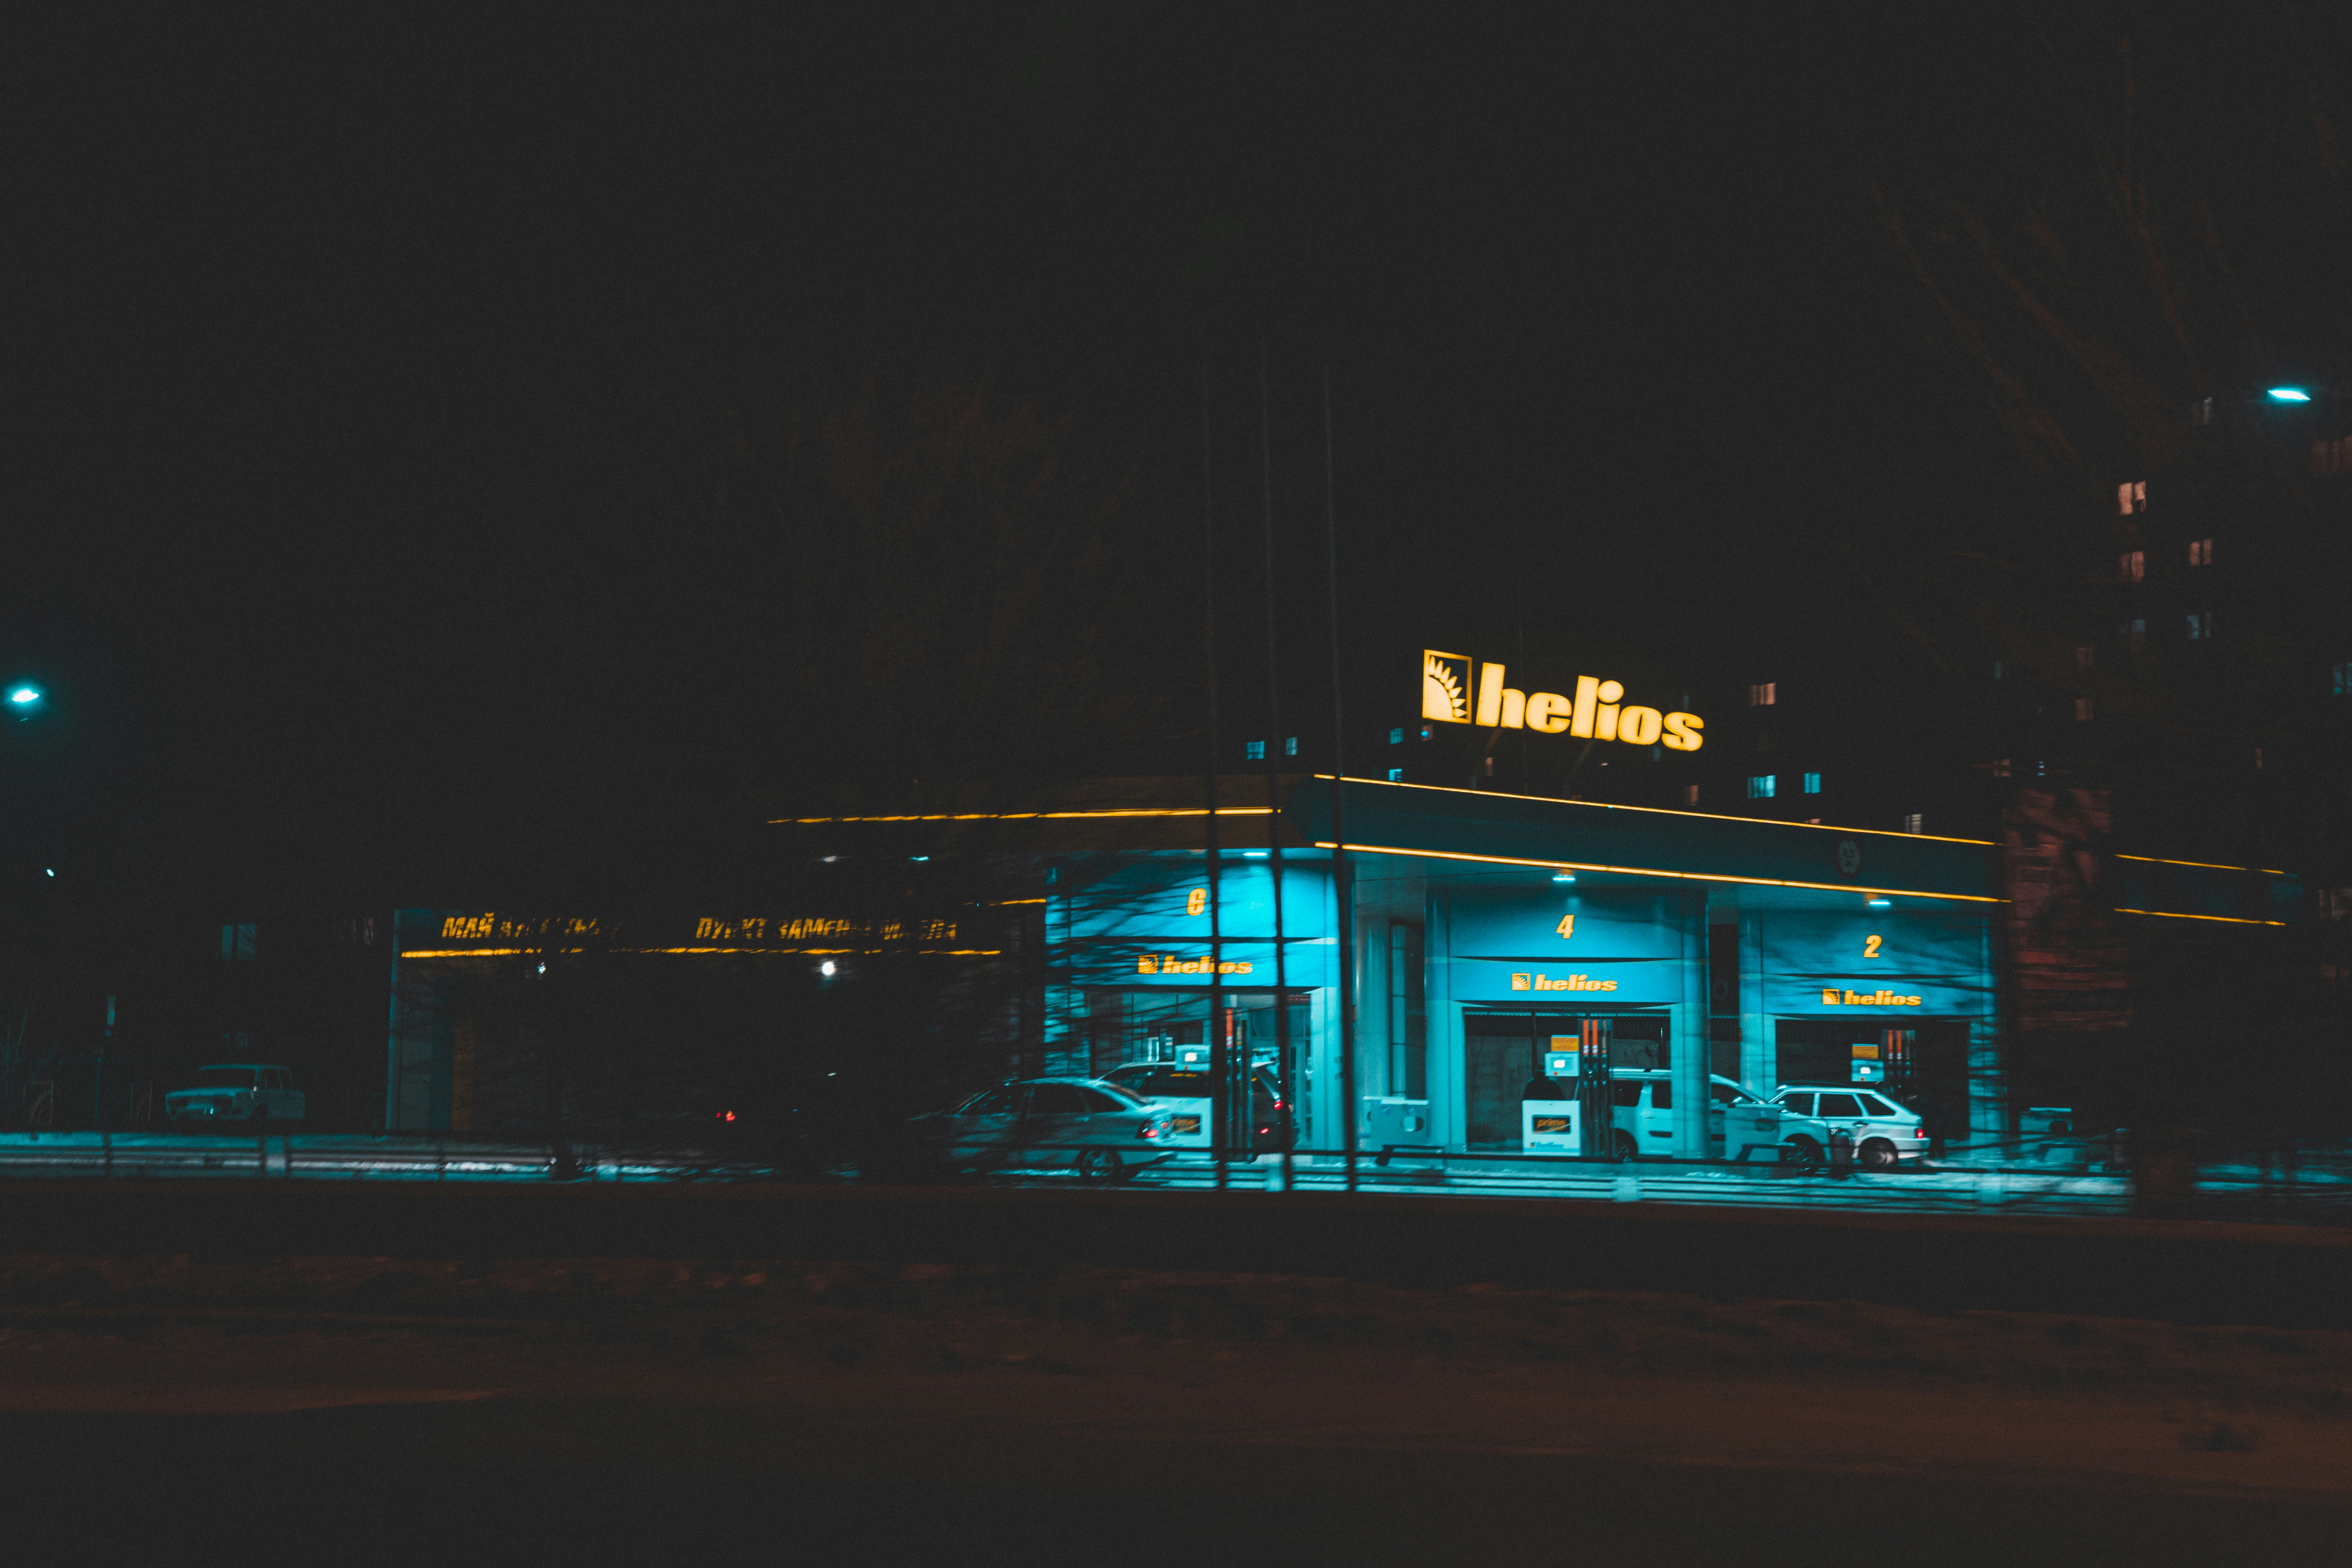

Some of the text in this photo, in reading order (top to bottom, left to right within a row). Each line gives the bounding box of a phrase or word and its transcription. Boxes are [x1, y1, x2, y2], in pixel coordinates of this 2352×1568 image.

[1475, 662, 1704, 751] helios
[1186, 888, 1207, 916] 6
[441, 912, 495, 939] МАЙ
[778, 918, 871, 939] ЗАМЕН
[1556, 914, 1575, 939] 4
[1863, 935, 1882, 958] 2
[1162, 955, 1253, 975] helios
[1534, 974, 1617, 992] helios
[1844, 989, 1922, 1006] helios
